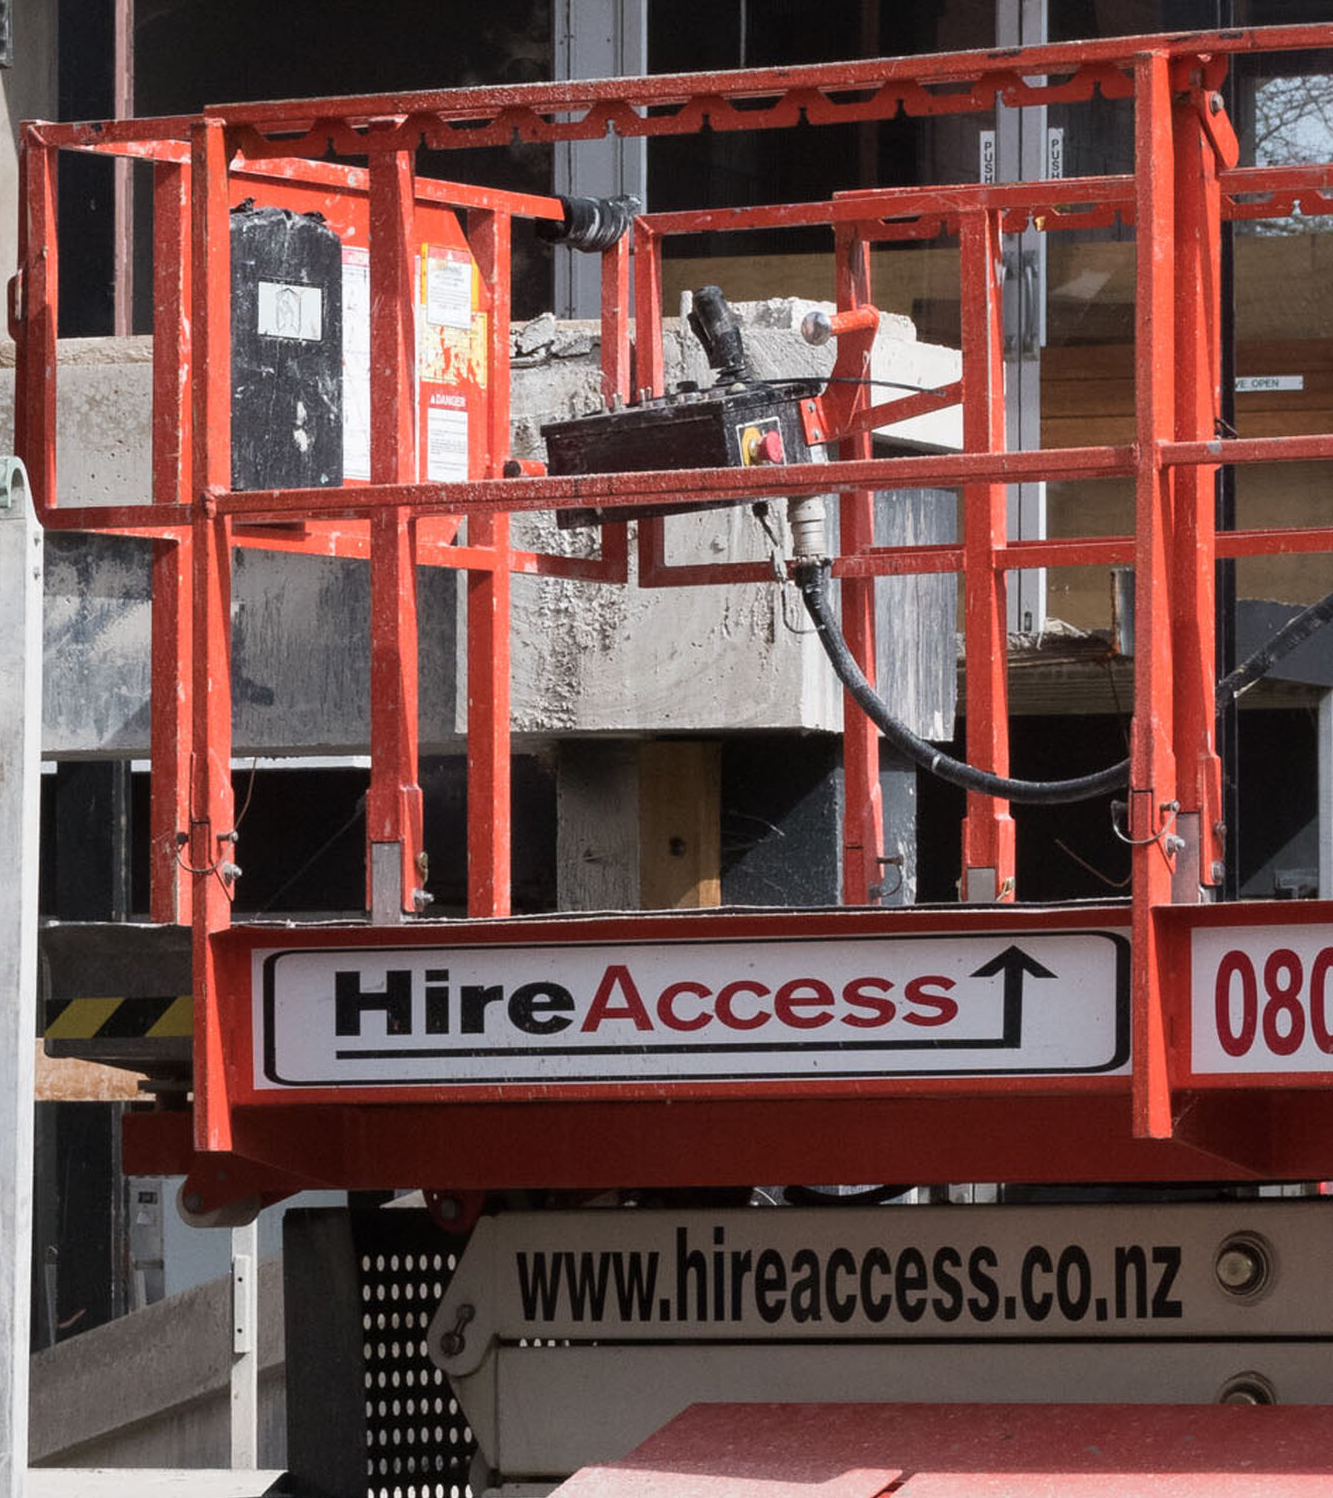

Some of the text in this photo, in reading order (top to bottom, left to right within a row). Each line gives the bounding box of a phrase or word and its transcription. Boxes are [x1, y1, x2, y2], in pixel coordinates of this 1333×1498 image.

[984, 141, 993, 184] PUSH
[1051, 138, 1061, 179] PUSH
[1251, 378, 1280, 389] OPEN
[335, 964, 959, 1037] HireAccess
[516, 1226, 1183, 1323] www.hireaccess.co.nz
